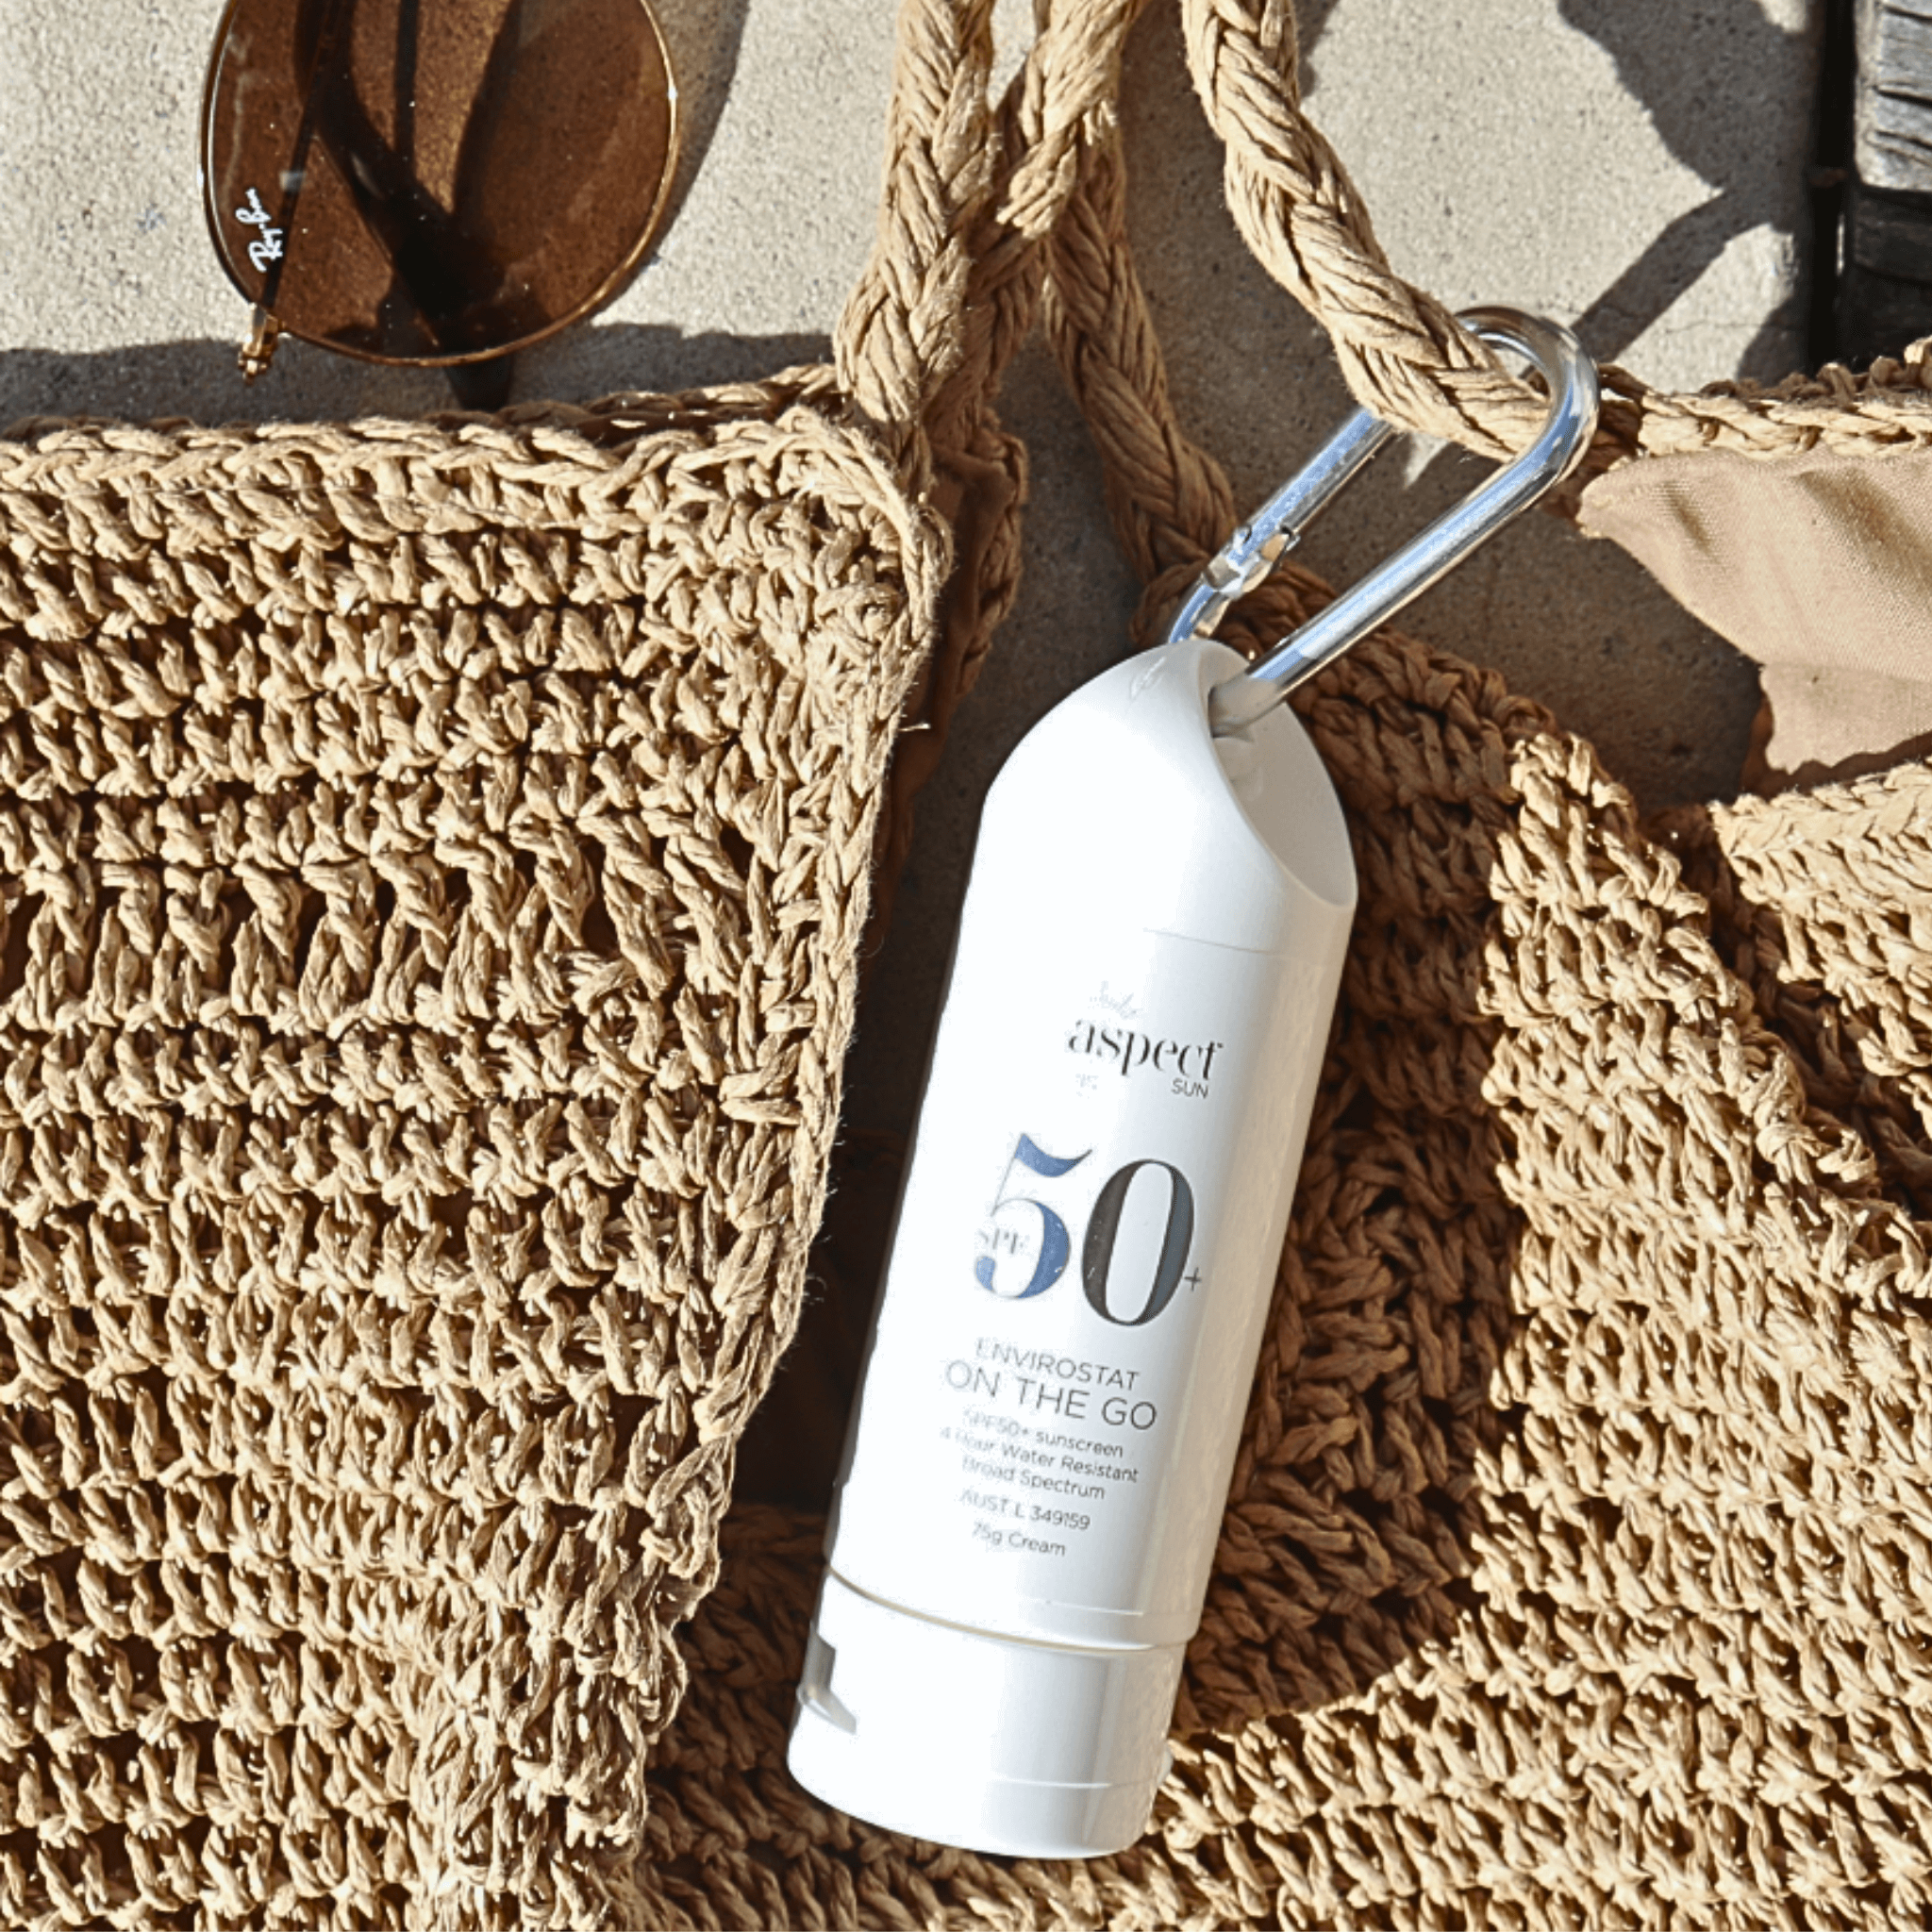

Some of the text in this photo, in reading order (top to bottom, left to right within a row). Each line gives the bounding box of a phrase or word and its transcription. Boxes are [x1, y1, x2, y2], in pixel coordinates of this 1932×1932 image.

[1067, 1019, 1224, 1080] aspect
[1171, 1078, 1209, 1099] SUN
[975, 1338, 1140, 1391] ENVIROSTAT
[945, 1359, 1158, 1431] ON THE GO
[1002, 1441, 1056, 1468] Water
[1061, 1454, 1140, 1483] Resistant
[1036, 1430, 1124, 1458] sunscreen
[963, 1455, 1106, 1500] Broad Spectrum
[960, 1489, 1091, 1531] AUST L 349159
[973, 1521, 1066, 1557] 75g Cream
